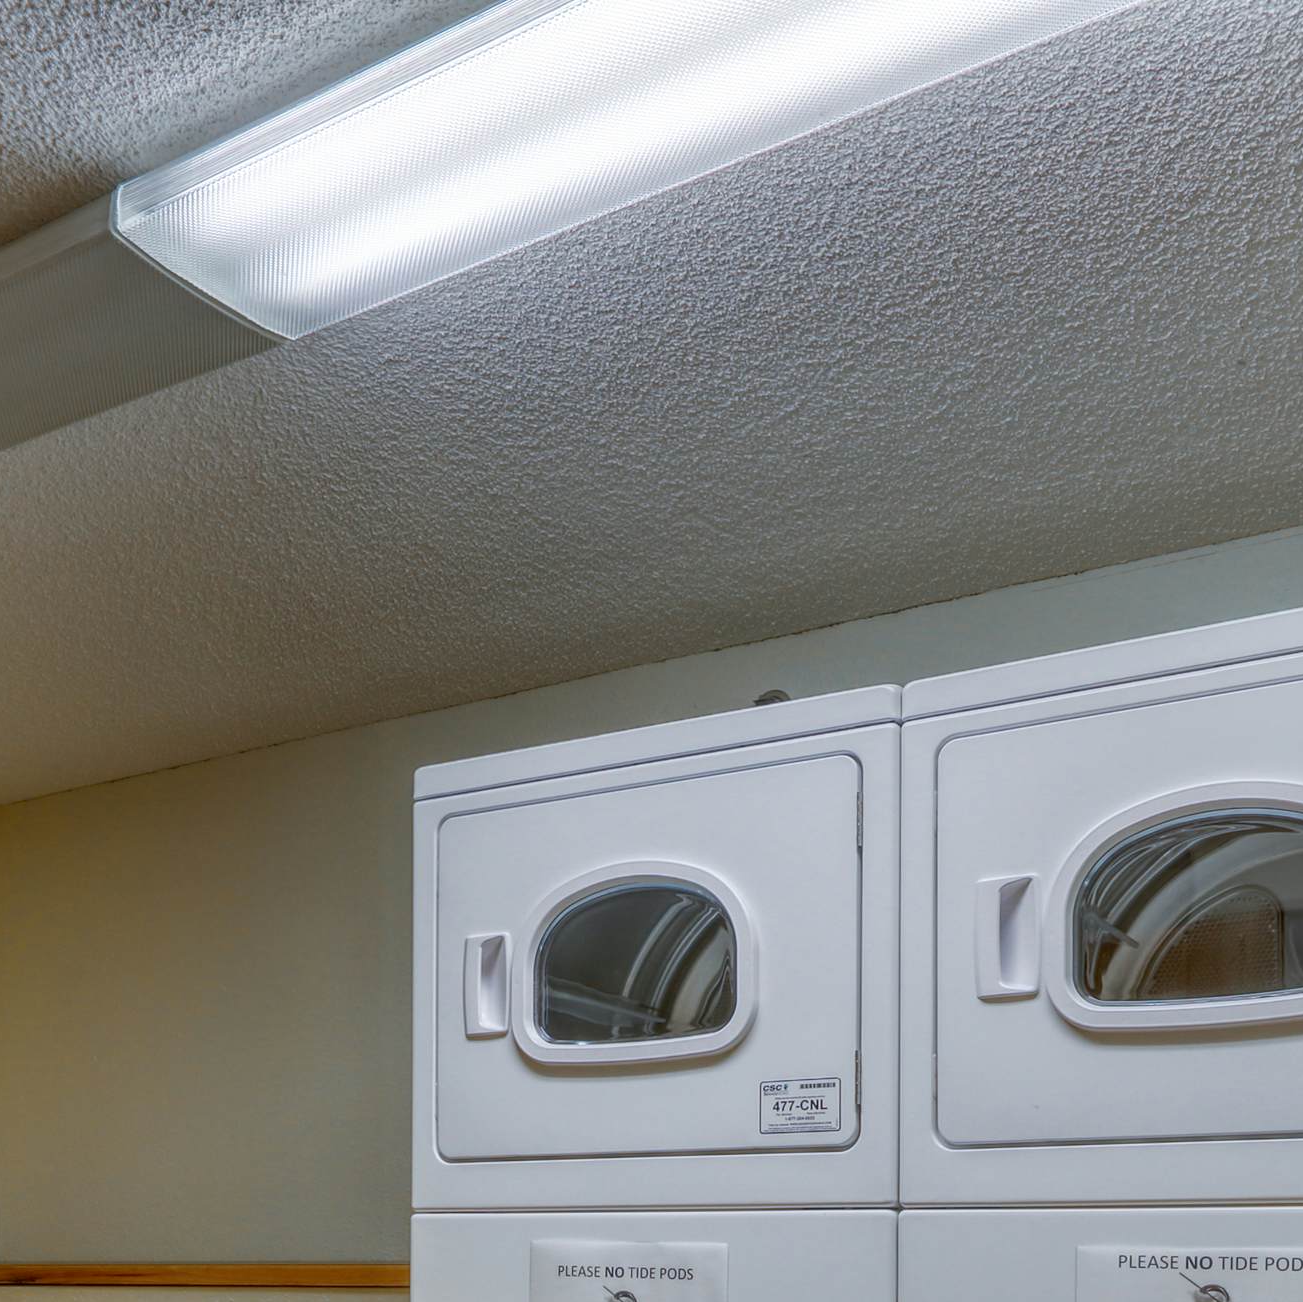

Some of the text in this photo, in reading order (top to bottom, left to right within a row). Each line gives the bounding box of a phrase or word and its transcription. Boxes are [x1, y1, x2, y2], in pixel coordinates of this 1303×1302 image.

[763, 1084, 782, 1092] CSC
[773, 1099, 828, 1112] 477-CNL
[1118, 1255, 1180, 1270] PLEASE
[1185, 1256, 1214, 1270] NO
[1219, 1256, 1258, 1271] TIDE
[558, 1265, 694, 1280] PLEASE NO TIDE PODS
